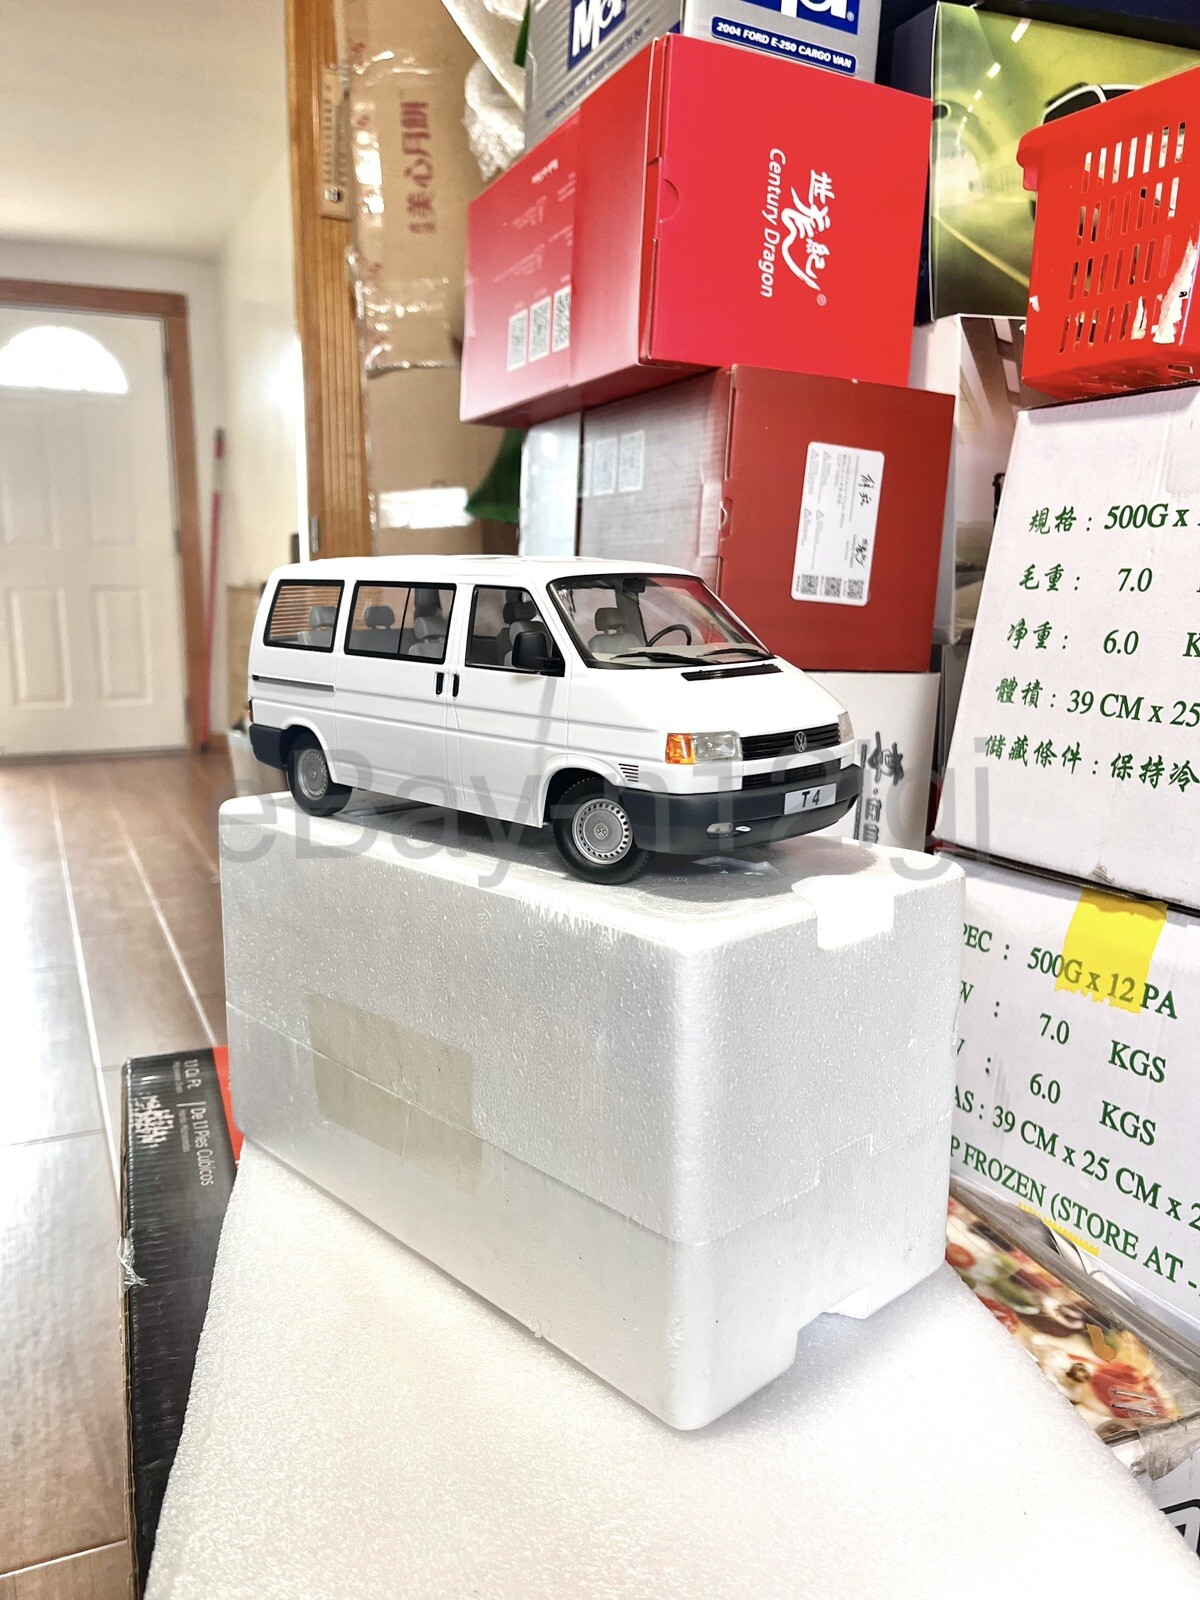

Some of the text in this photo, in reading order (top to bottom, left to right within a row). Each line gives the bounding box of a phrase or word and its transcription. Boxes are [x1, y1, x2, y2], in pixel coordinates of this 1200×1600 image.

[716, 22, 853, 69] 2004 FORD E-250 CARGO VAN
[757, 148, 787, 298] Century Dragon
[1104, 503, 1169, 530] 500G
[1172, 509, 1190, 528] x
[1118, 567, 1153, 592] 7.0
[1103, 629, 1139, 655] 6.0
[1066, 689, 1095, 715] 39
[1099, 693, 1144, 721] CM
[1147, 705, 1164, 723] x
[1170, 700, 1200, 728] 25
[963, 923, 993, 953] EC
[1027, 946, 1083, 984] 500G
[1086, 971, 1101, 992] x
[1107, 972, 1136, 1003] 12
[1139, 982, 1178, 1020] PA
[1039, 1012, 1070, 1045] 7.0
[1108, 1039, 1167, 1084] KGS
[1029, 1073, 1061, 1105] 6.0
[1099, 1100, 1156, 1146] KGS
[992, 1104, 1017, 1133] 39
[1020, 1119, 1060, 1159] CM
[1062, 1145, 1076, 1167] x
[1081, 1149, 1111, 1182] 25
[1115, 1167, 1162, 1210] CM
[1165, 1196, 1182, 1222] x
[962, 1142, 1047, 1208] FROZEN
[1050, 1192, 1139, 1261] (STORE
[1143, 1245, 1184, 1283] AT
